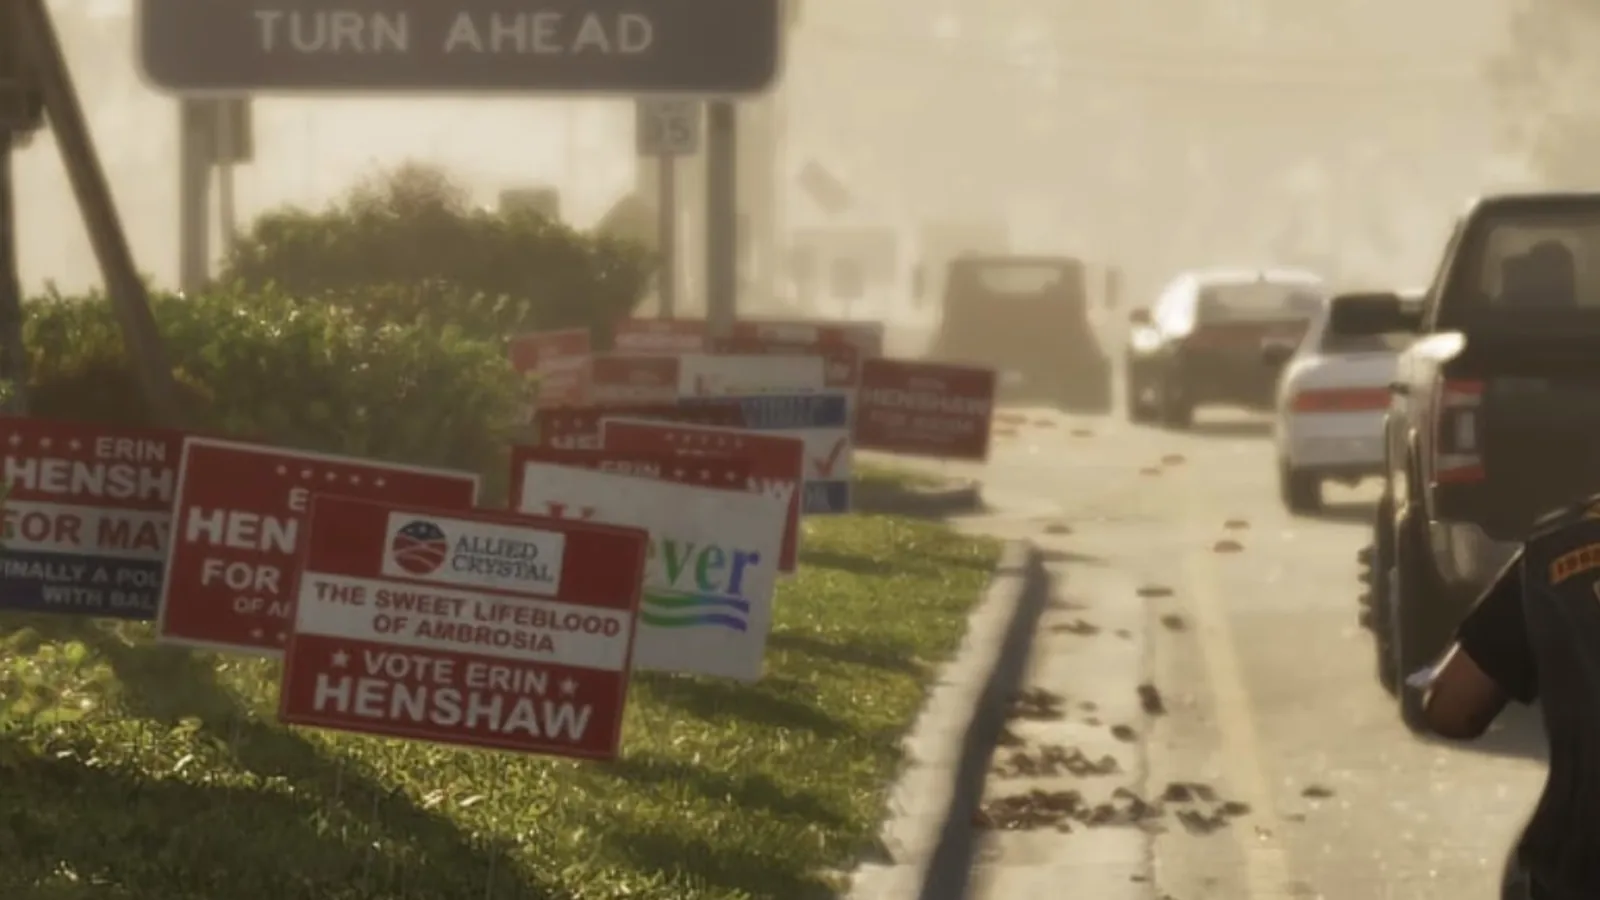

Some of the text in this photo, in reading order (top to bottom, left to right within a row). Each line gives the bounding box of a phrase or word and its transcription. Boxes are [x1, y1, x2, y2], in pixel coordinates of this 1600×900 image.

[254, 10, 654, 54] TURN AHEAD
[95, 436, 166, 463] ERIN
[97, 517, 169, 552] MA
[186, 505, 298, 556] HEN
[454, 532, 539, 561] ALLIED
[91, 566, 109, 584] A
[201, 558, 281, 595] FOR
[451, 554, 554, 583] CRYSTAL
[42, 583, 104, 608] WITH
[233, 597, 265, 614] OF
[314, 581, 620, 637] THE SWEET LIFEBLOOD
[372, 613, 556, 653] OF AMBROSIA
[363, 649, 549, 696] VOTE ERIN
[313, 672, 592, 741] HENSHAW
